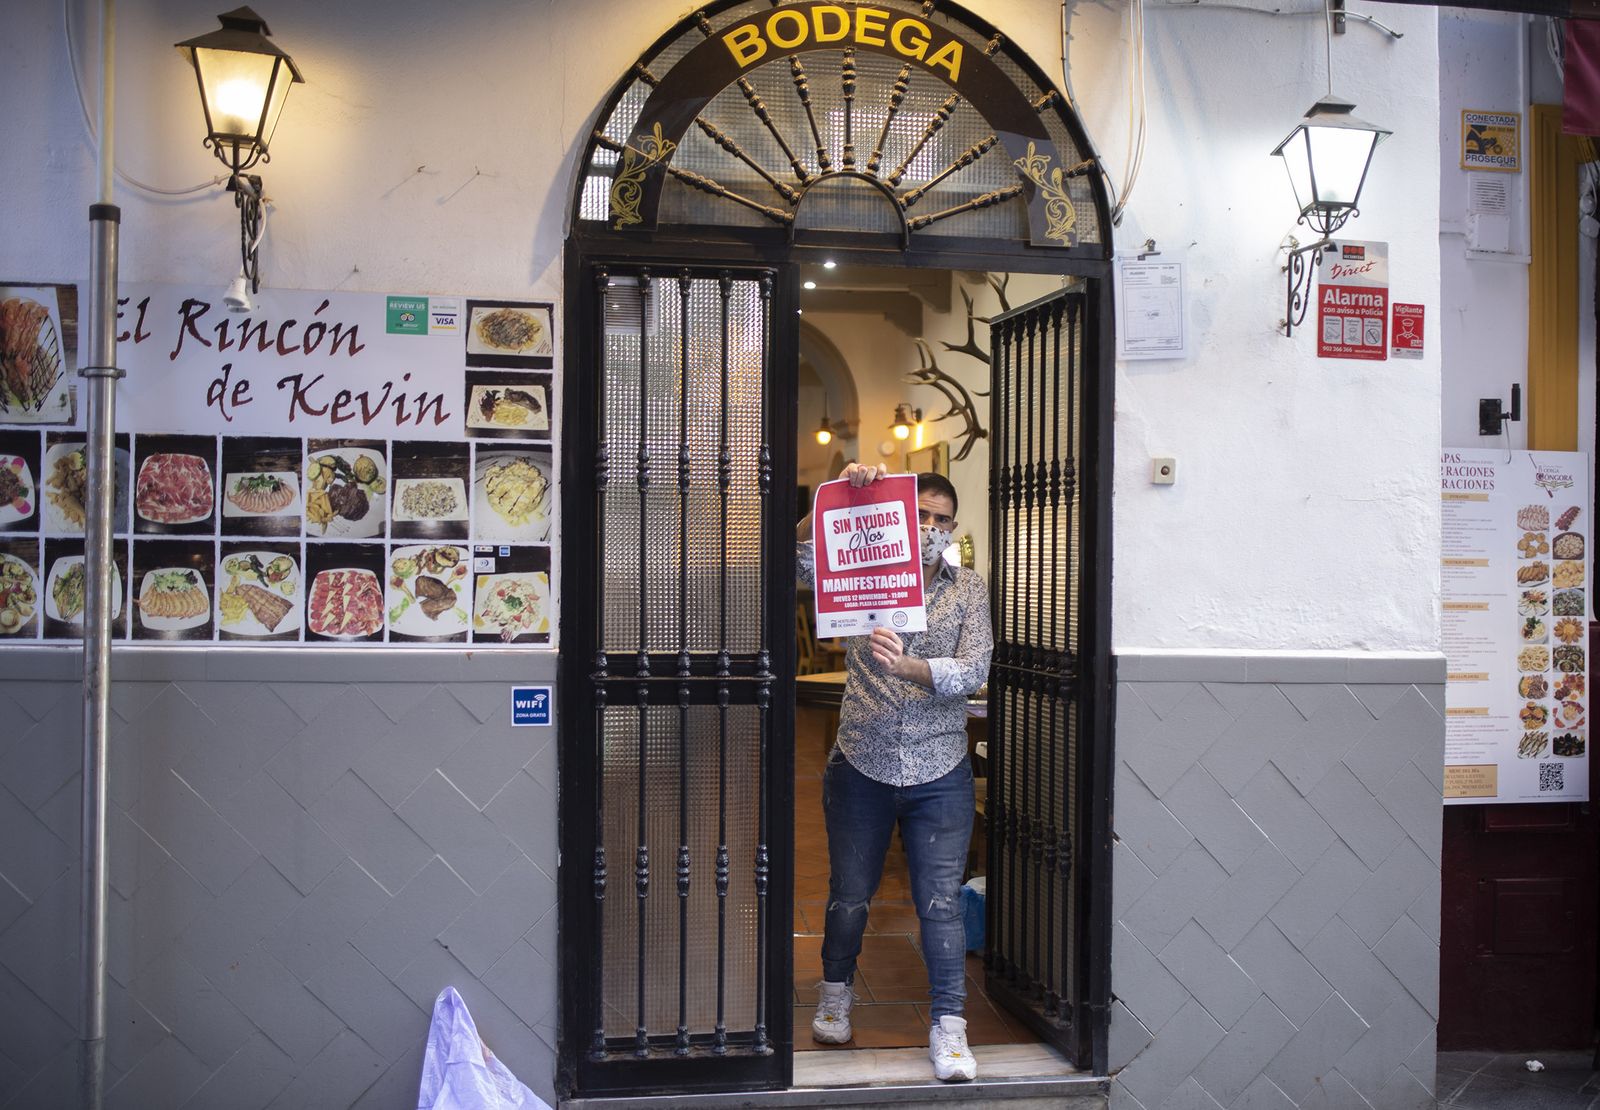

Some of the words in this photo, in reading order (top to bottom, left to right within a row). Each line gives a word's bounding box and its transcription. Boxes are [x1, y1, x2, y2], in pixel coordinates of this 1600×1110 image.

[722, 5, 964, 83] BODEGA
[1466, 114, 1516, 122] CONECTADA
[1465, 154, 1516, 164] PROSEGUR
[1330, 260, 1377, 280] Direct
[1323, 288, 1384, 307] Alarma
[389, 302, 415, 310] REVIEW
[1361, 308, 1384, 316] Policía
[1395, 305, 1423, 314] Vigilante
[436, 317, 454, 325] VISA
[169, 298, 366, 361] Rincón
[206, 363, 254, 422] de
[276, 372, 452, 427] Kevin
[1446, 466, 1495, 477] RACIONES
[1442, 479, 1495, 490] RACIONES
[833, 518, 851, 534] SIN
[855, 511, 900, 531] AYUDAS
[849, 526, 884, 550] Nos
[837, 540, 904, 566] Arruinan!
[822, 572, 917, 593] MANIFESTACIÓN
[833, 595, 851, 603] JUEVES
[858, 593, 888, 601] NOVIEMBRE
